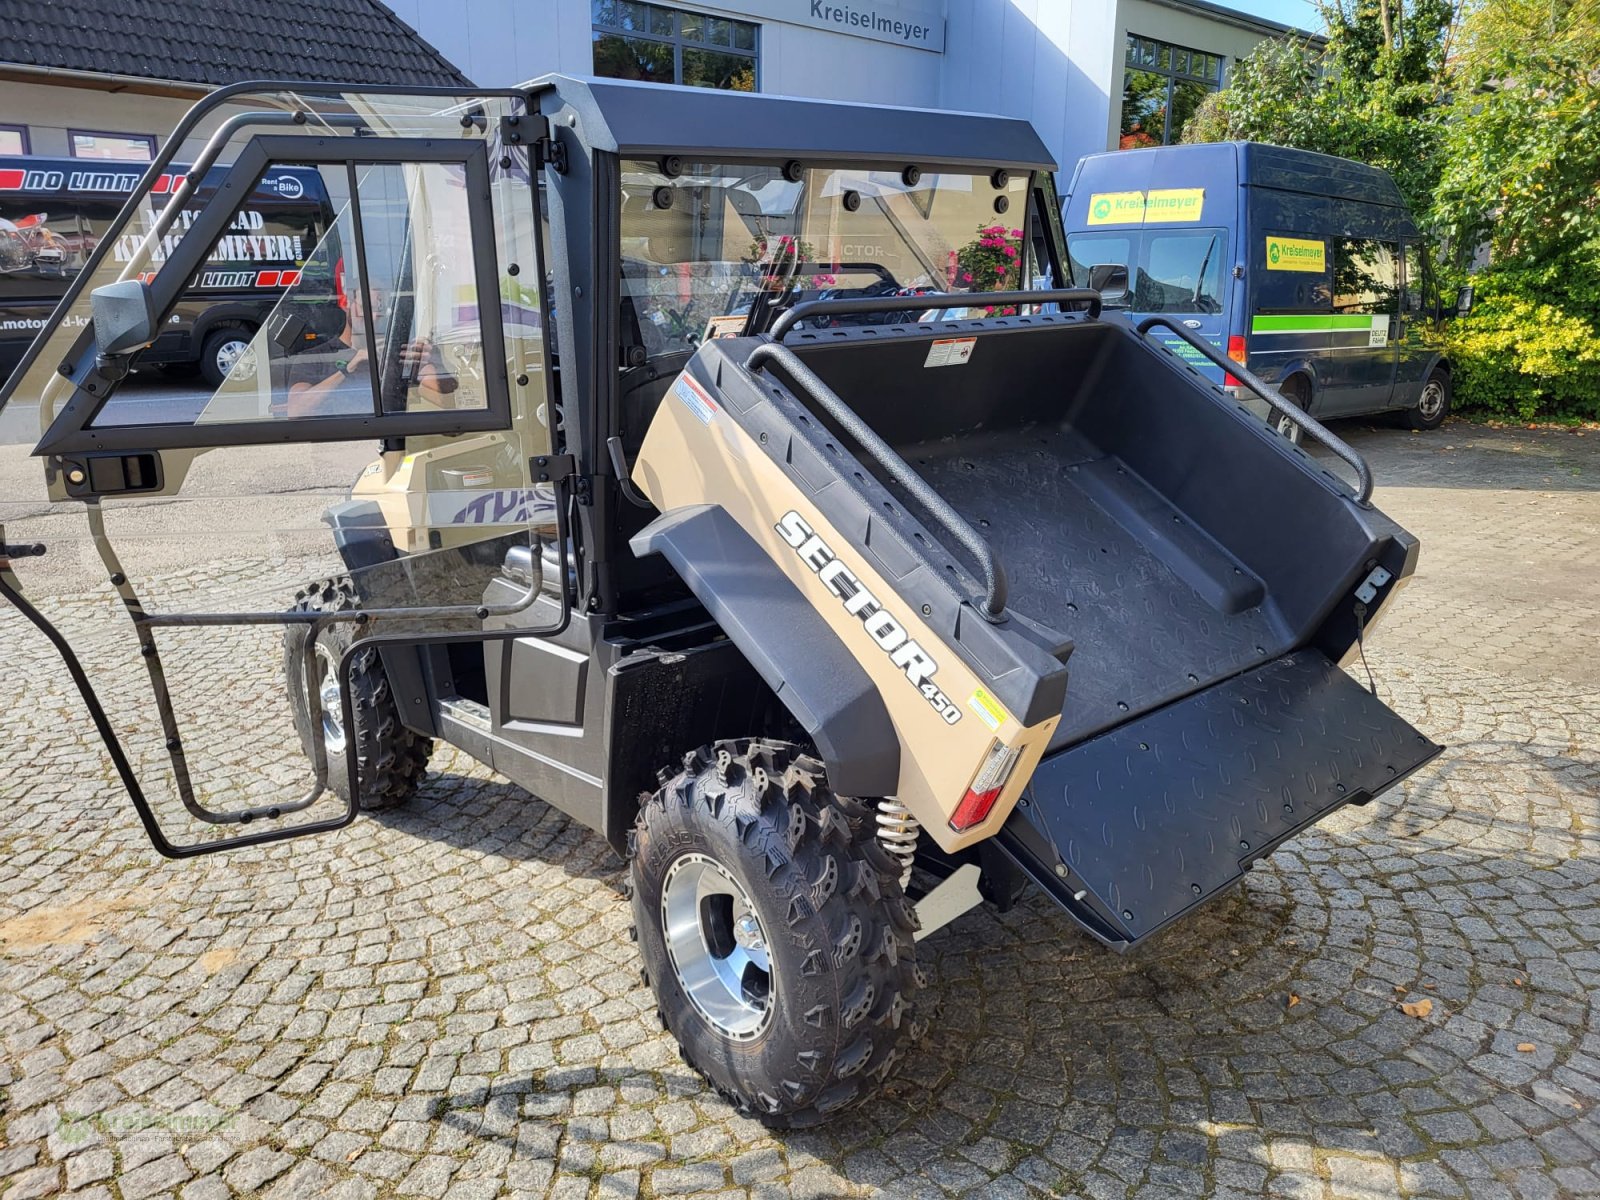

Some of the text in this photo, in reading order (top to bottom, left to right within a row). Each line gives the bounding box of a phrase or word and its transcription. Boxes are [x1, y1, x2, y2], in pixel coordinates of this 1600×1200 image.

[810, 0, 930, 40] Kreiselmeyer
[24, 171, 140, 192] NO LIMIT
[279, 183, 299, 191] Bike
[1115, 196, 1199, 210] Kreiselmeyer
[1281, 243, 1323, 260] Kreiselmeyer
[201, 271, 256, 288] LIMIT
[774, 510, 963, 725] SECTOR 450
